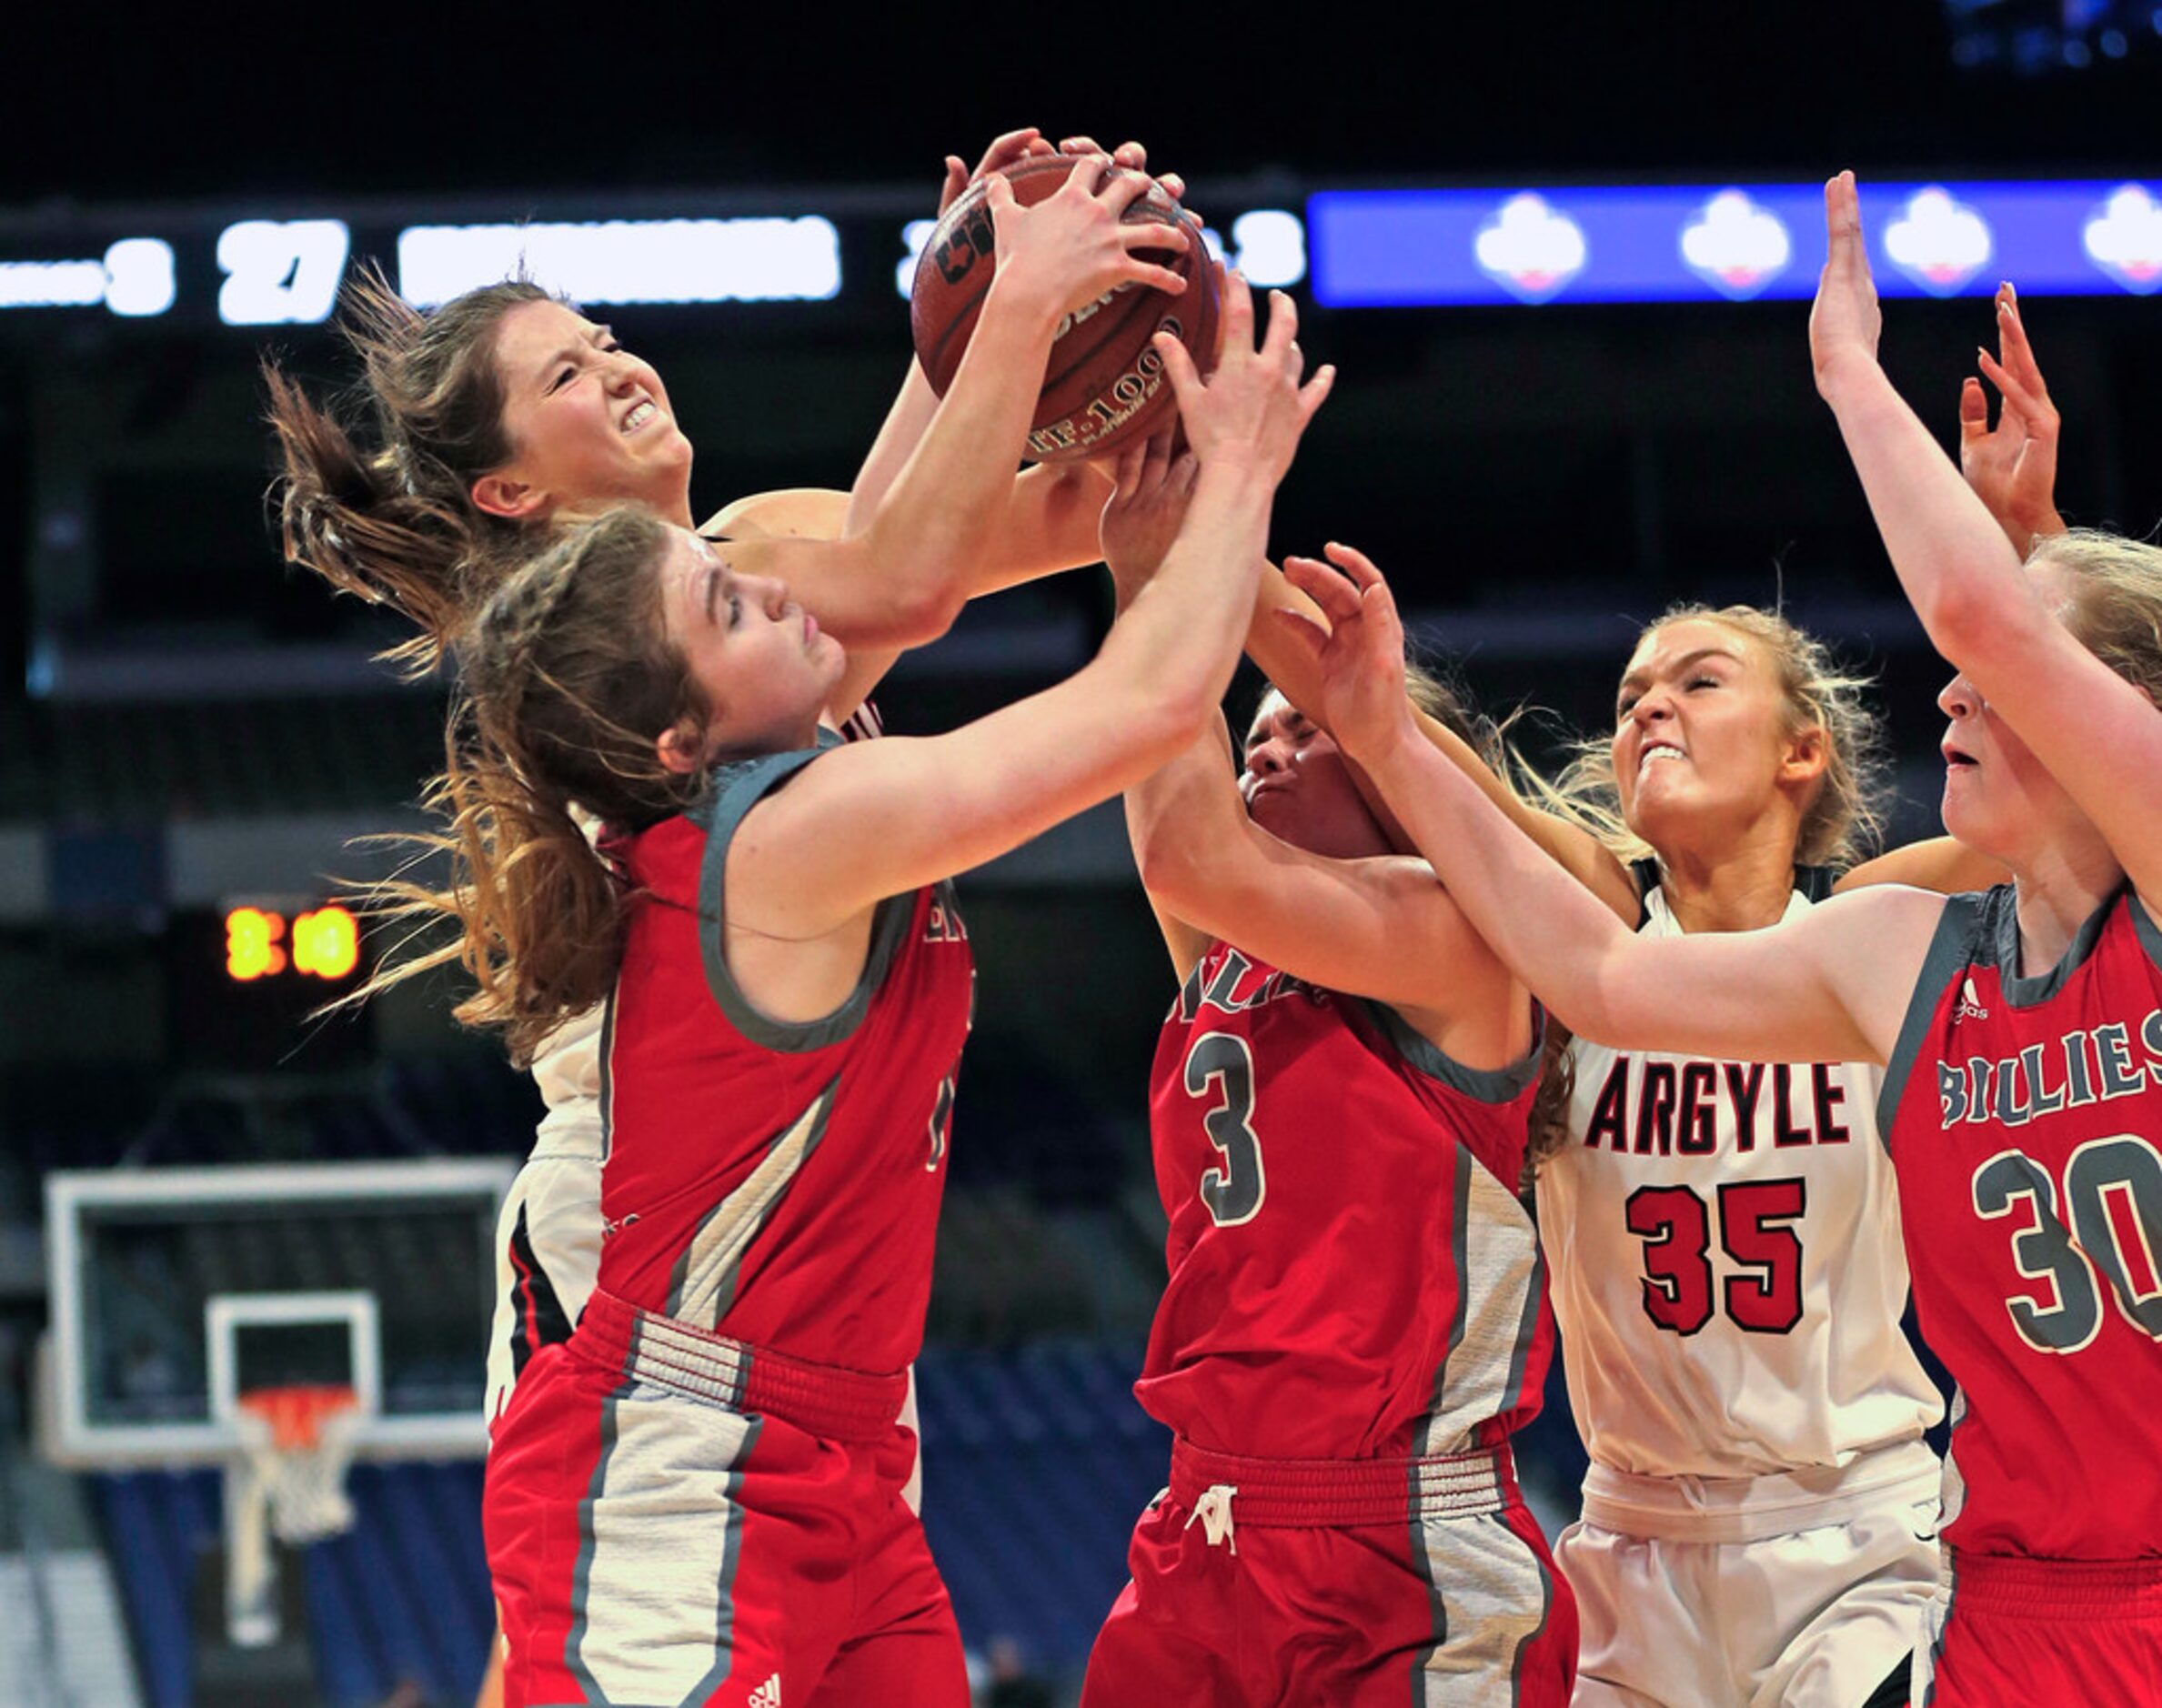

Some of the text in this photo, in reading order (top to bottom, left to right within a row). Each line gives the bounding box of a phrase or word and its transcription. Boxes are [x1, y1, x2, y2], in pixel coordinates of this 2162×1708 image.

[1184, 1031, 1266, 1228] 3
[1584, 1055, 1850, 1157] ARGYLE
[1624, 1176, 1806, 1337] 35
[1971, 1132, 2162, 1355] 30
